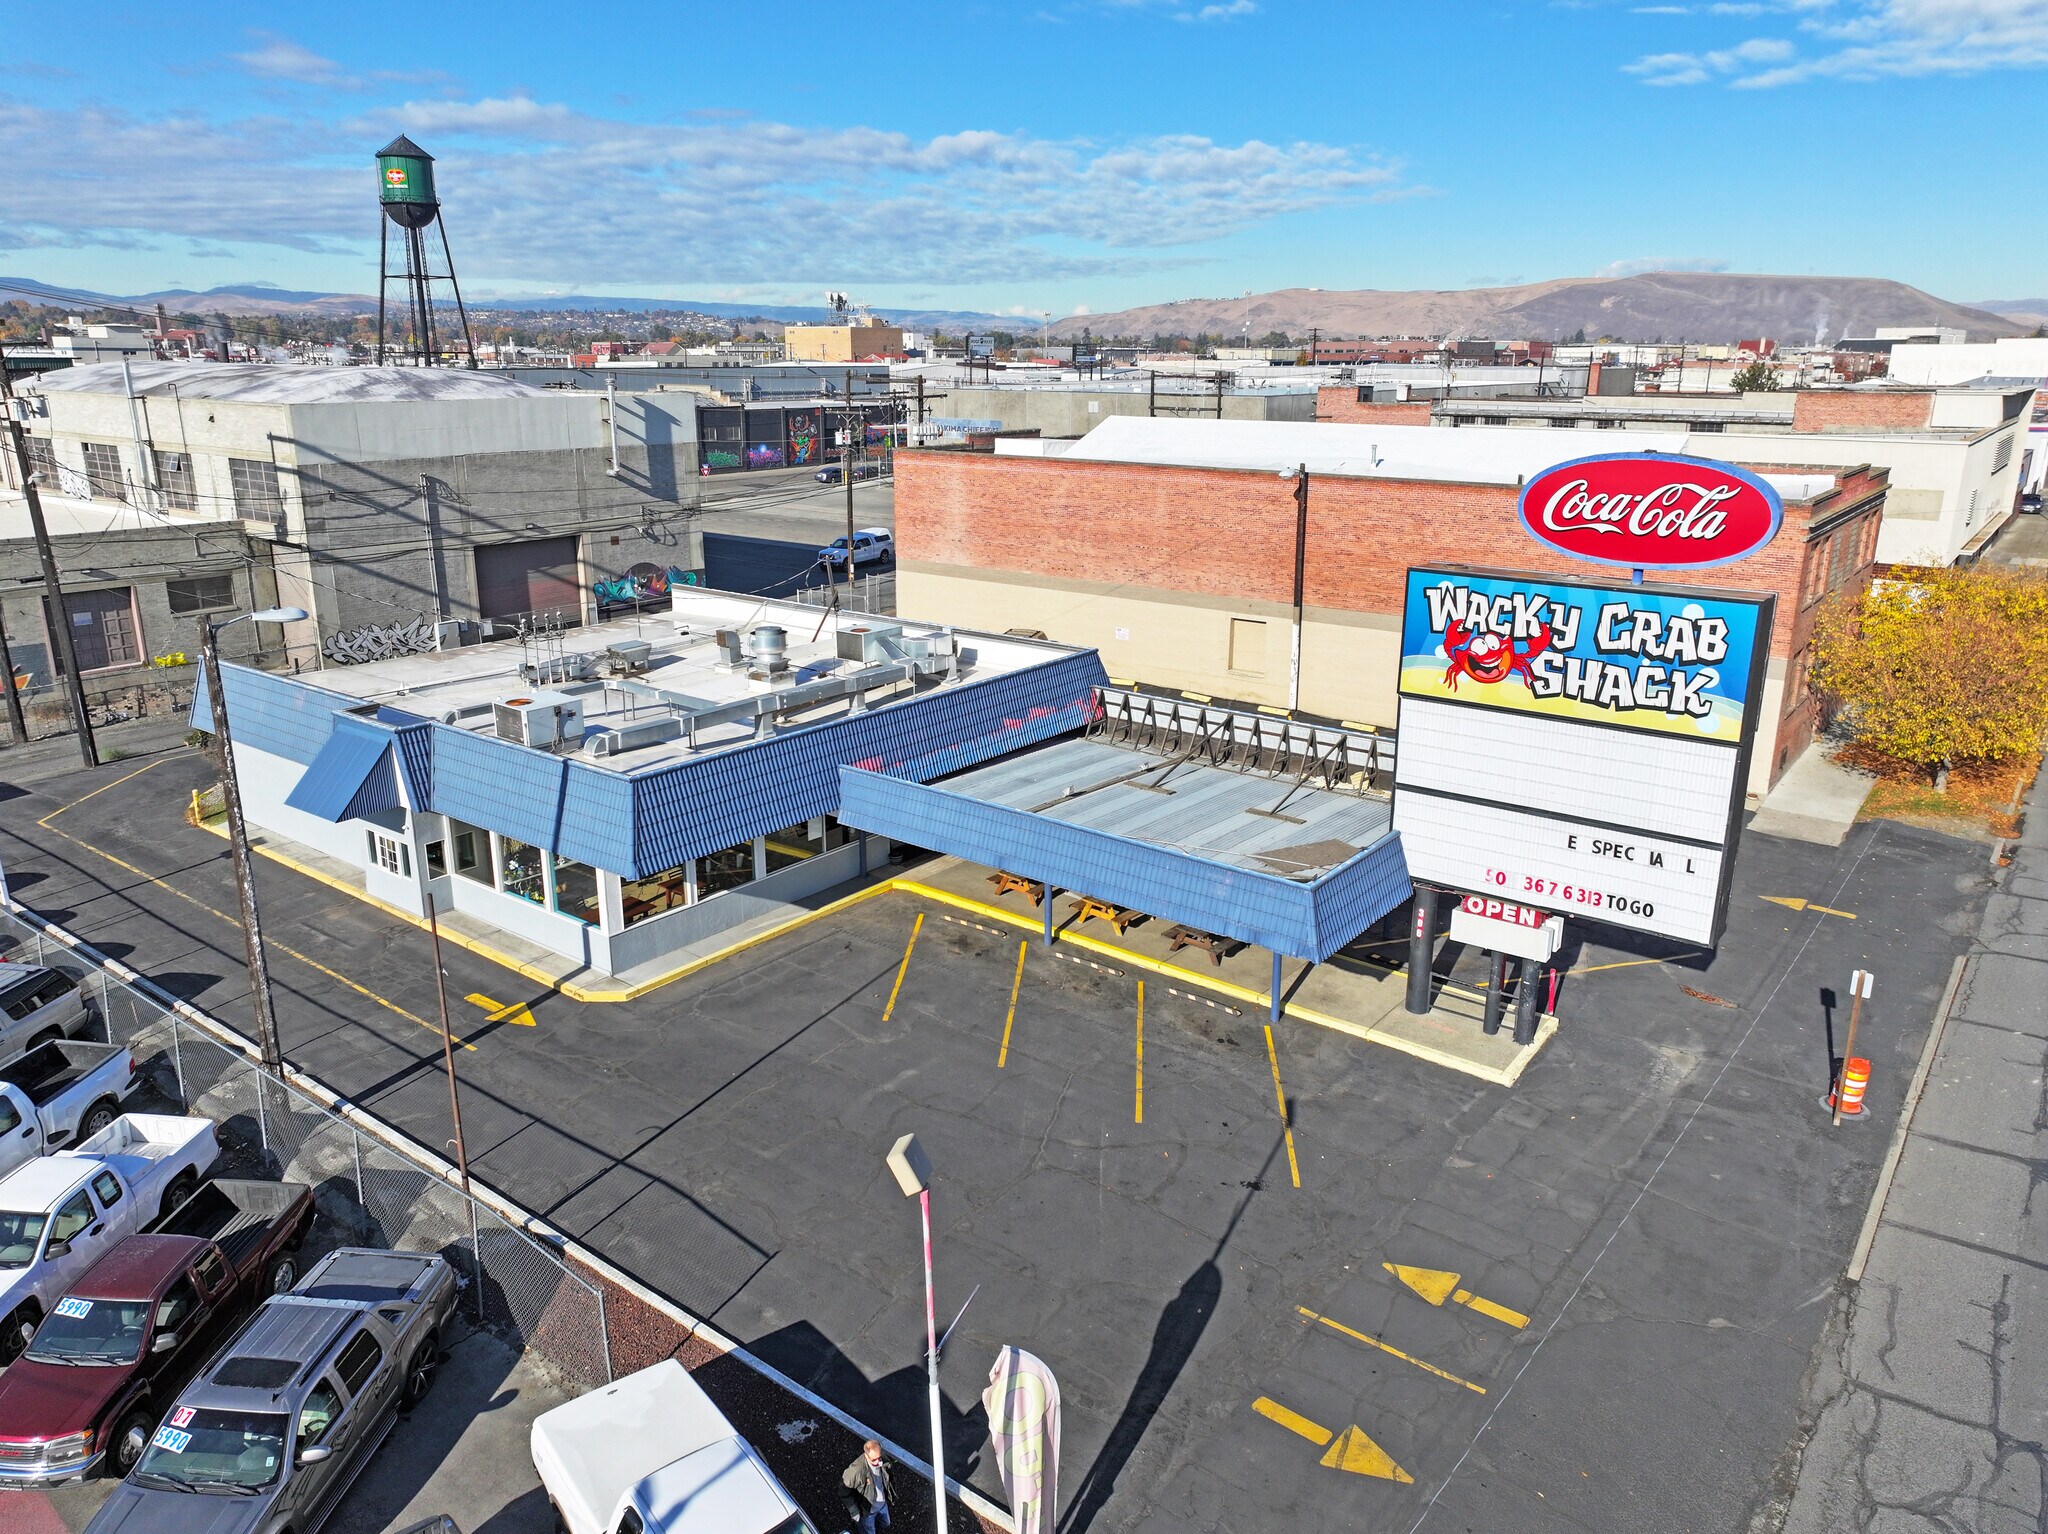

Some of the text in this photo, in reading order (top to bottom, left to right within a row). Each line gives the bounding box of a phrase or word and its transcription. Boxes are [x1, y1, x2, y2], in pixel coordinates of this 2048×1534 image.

[1542, 479, 1742, 539] Coca-Cola
[1424, 586, 1729, 665] WACKY CRAB
[1530, 650, 1714, 716] SHACK
[1467, 896, 1536, 926] OPEN
[57, 1299, 91, 1316] 5990
[173, 1407, 193, 1424] 07
[154, 1427, 189, 1451] 5990
